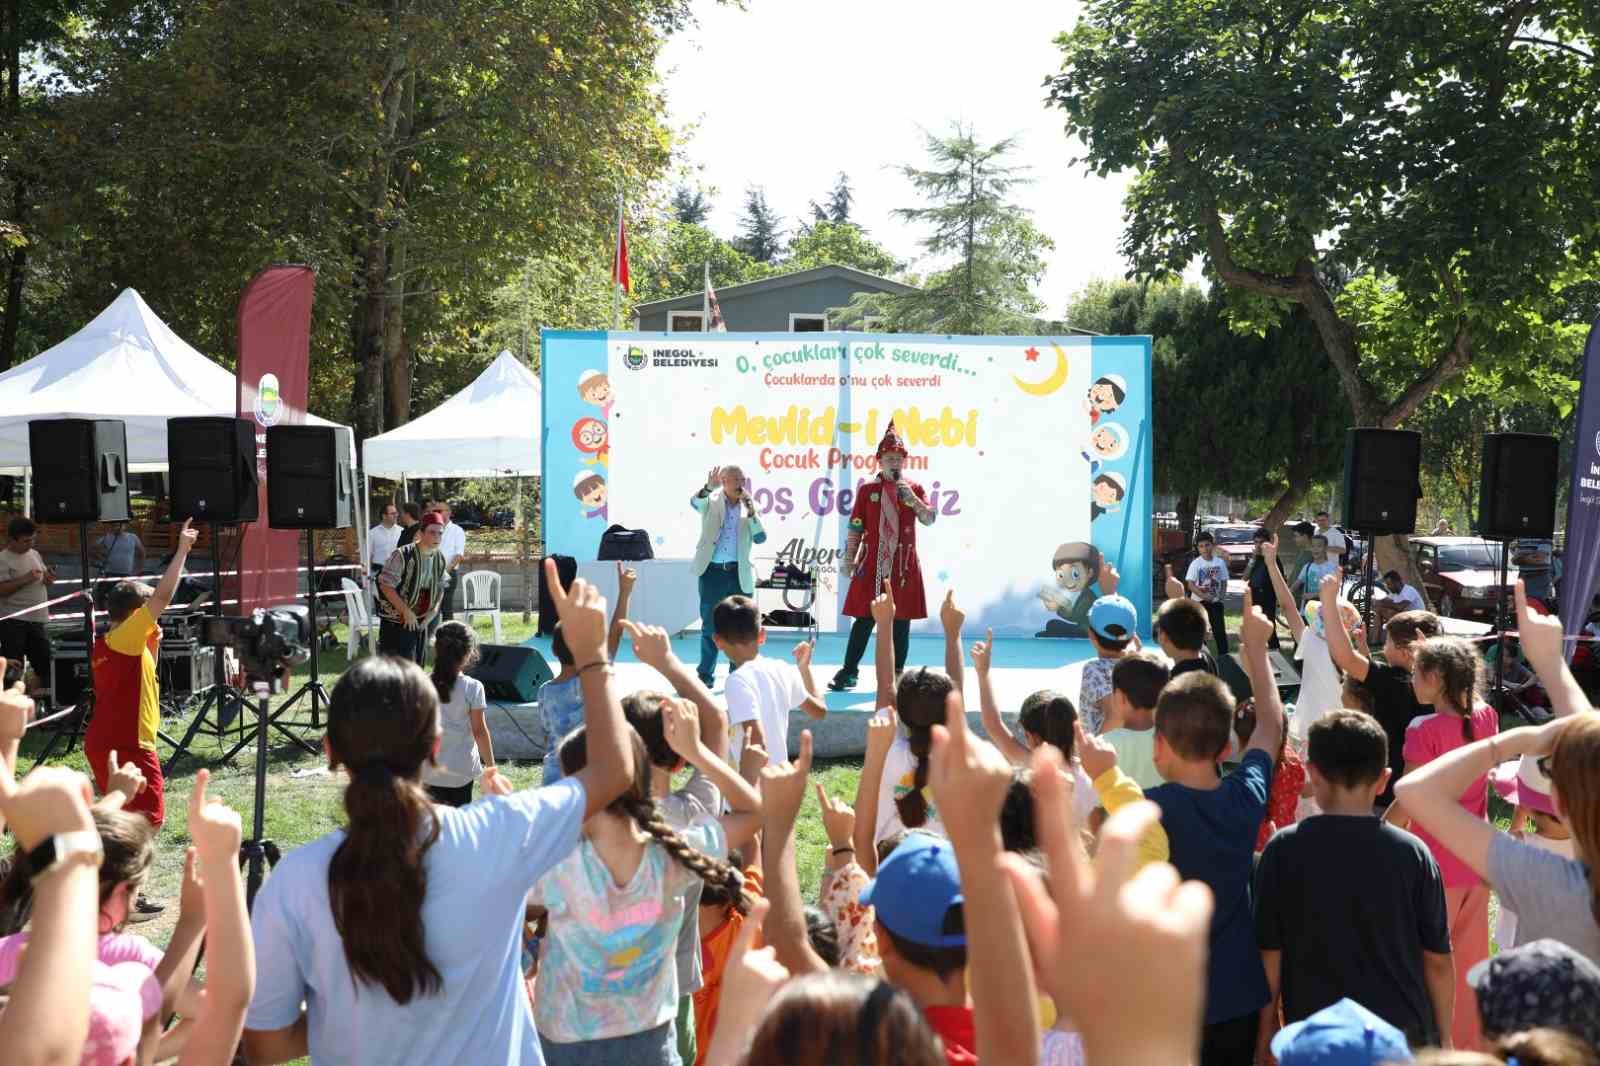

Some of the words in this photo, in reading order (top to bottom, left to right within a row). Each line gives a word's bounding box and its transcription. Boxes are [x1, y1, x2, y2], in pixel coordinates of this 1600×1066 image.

[854, 342, 886, 365] çok
[764, 372, 836, 388] Çocuklarda
[871, 374, 893, 390] çok
[896, 374, 942, 387] severdi
[891, 405, 979, 447] Nebi
[759, 447, 821, 474] Çocuk
[828, 447, 929, 474] Progmı
[744, 477, 794, 520] oş
